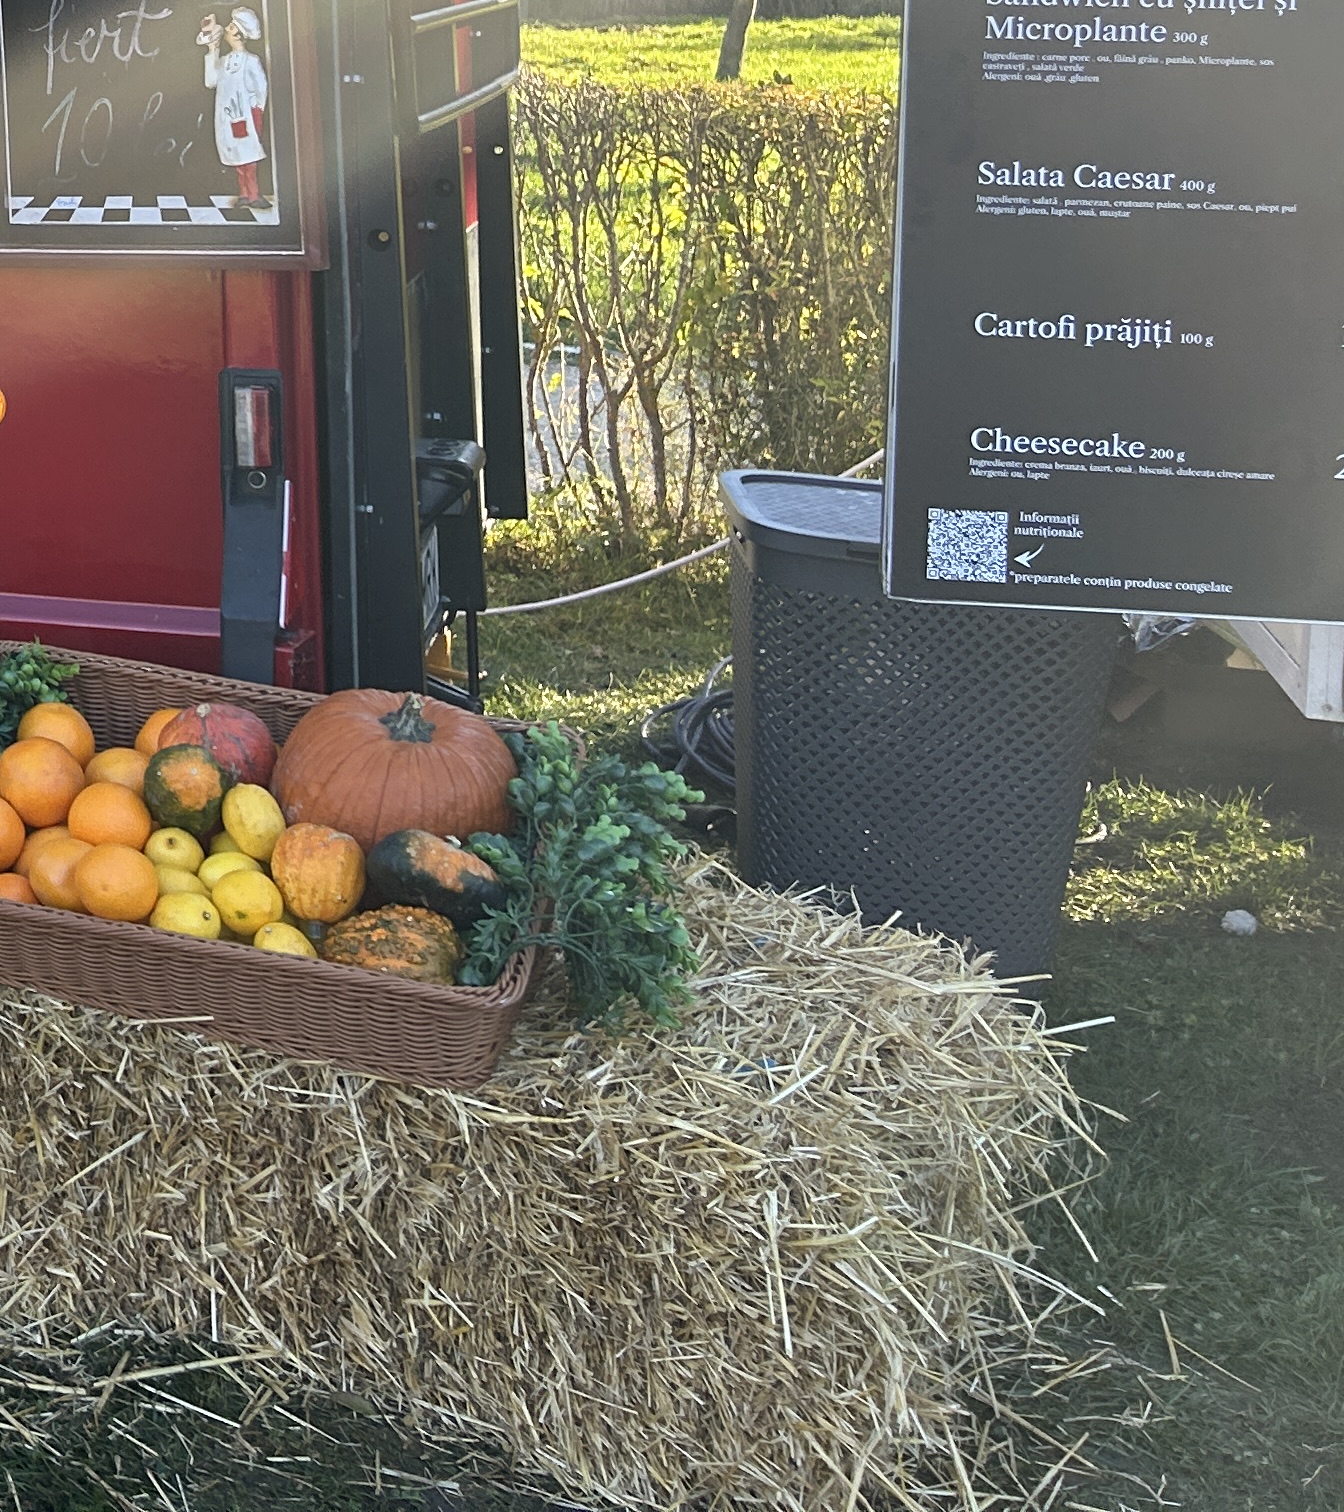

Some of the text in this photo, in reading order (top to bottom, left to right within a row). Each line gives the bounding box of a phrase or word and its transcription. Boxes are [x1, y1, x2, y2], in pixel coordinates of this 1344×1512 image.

[984, 15, 1209, 48] Microplante 300 g
[41, 86, 113, 178] 10
[977, 160, 1216, 195] Salata Caesar 400 g
[974, 312, 1214, 350] Cartofi prăjiți 100 g
[969, 428, 1186, 463] Cheesecake 200 g
[1013, 525, 1086, 539] nutriționale
[1018, 511, 1081, 526] Informații
[1124, 577, 1173, 590] produse
[1175, 581, 1233, 593] congelate
